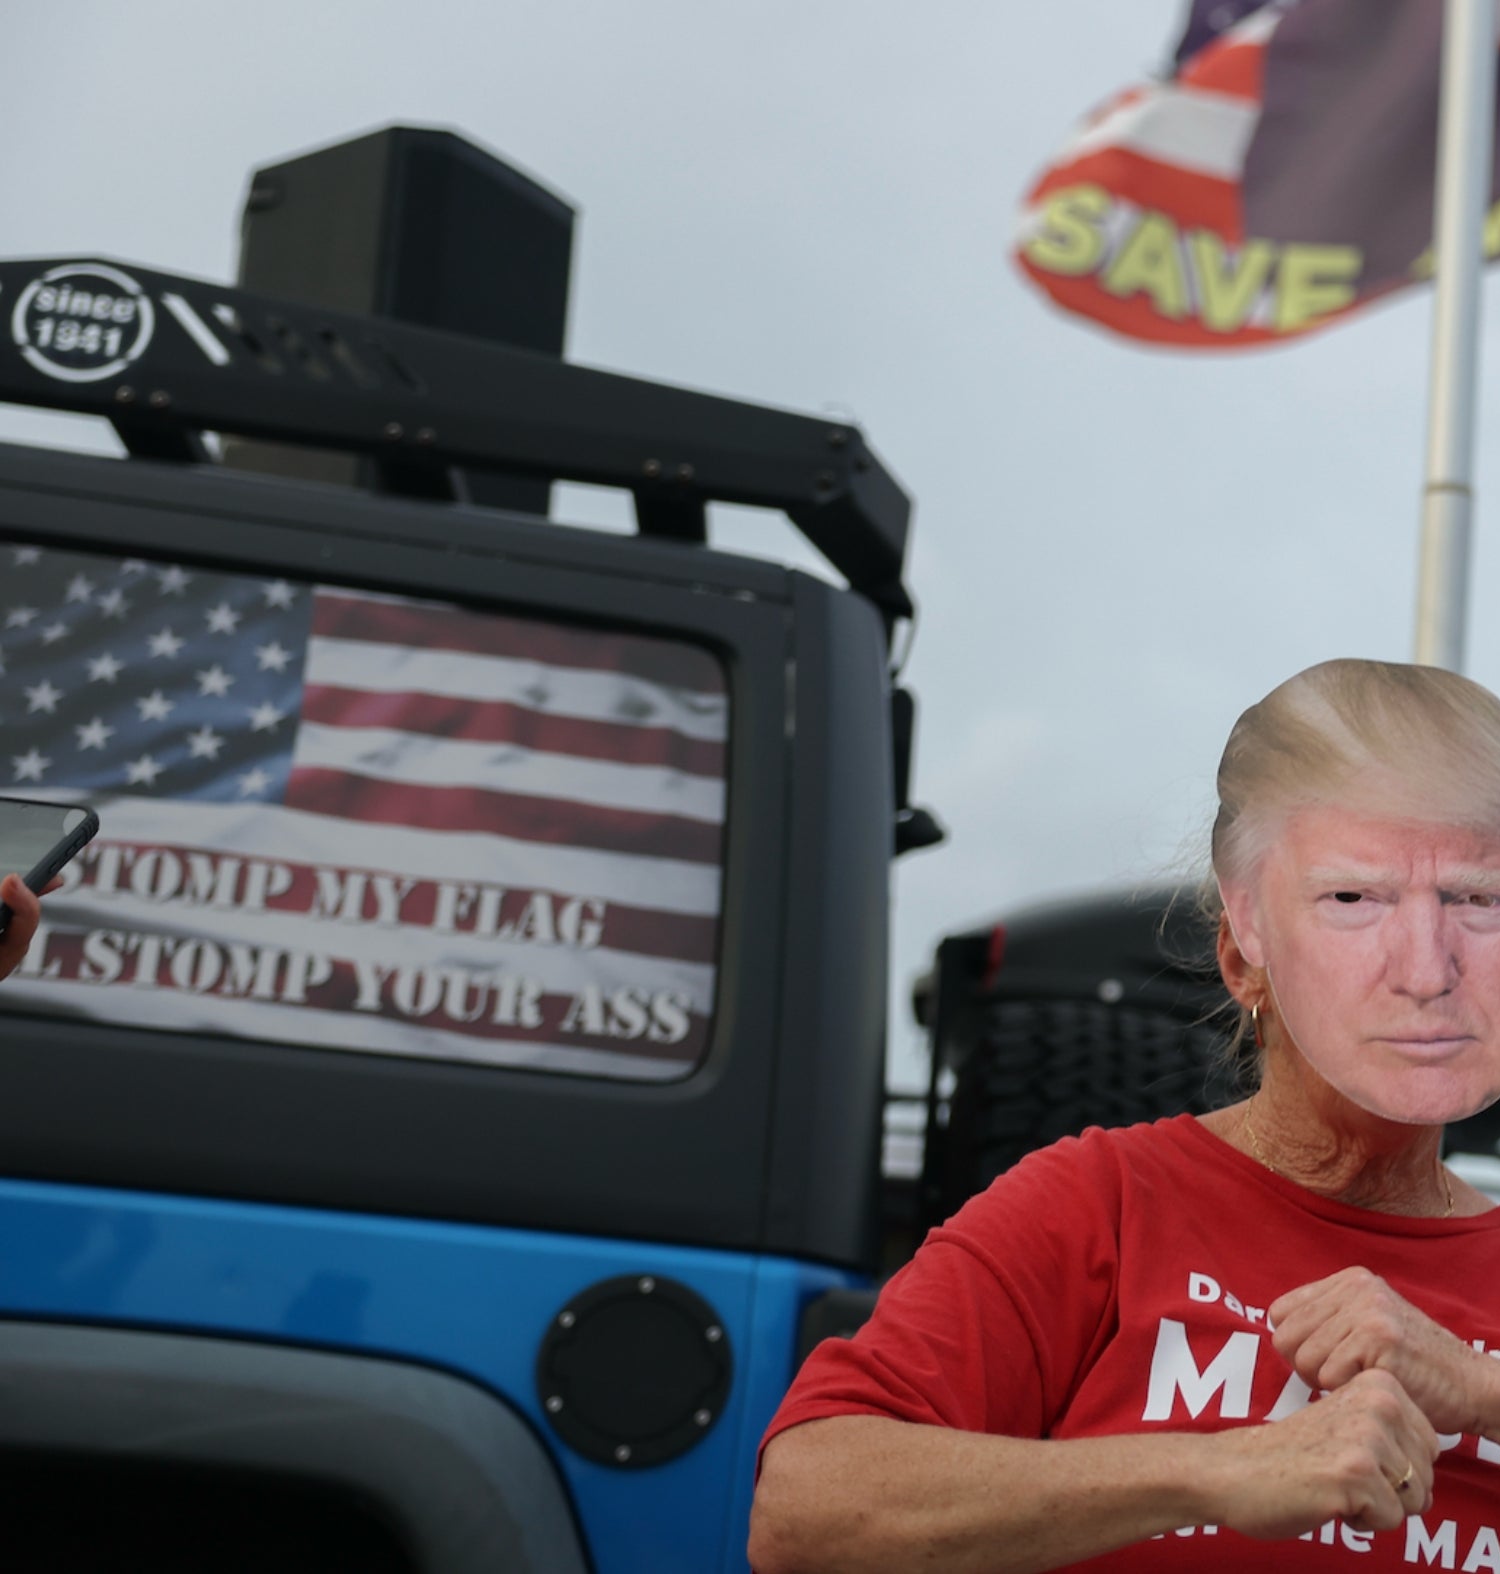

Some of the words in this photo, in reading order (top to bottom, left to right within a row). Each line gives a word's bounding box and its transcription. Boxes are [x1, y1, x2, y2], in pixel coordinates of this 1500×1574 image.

[1030, 184, 1364, 334] SAVE
[34, 284, 135, 323] since
[34, 318, 121, 356] 1941
[308, 868, 418, 925] MY
[430, 878, 608, 950] FLAG
[80, 928, 336, 1003] STOMP
[352, 960, 545, 1030] YOUR
[558, 982, 692, 1044] ASS
